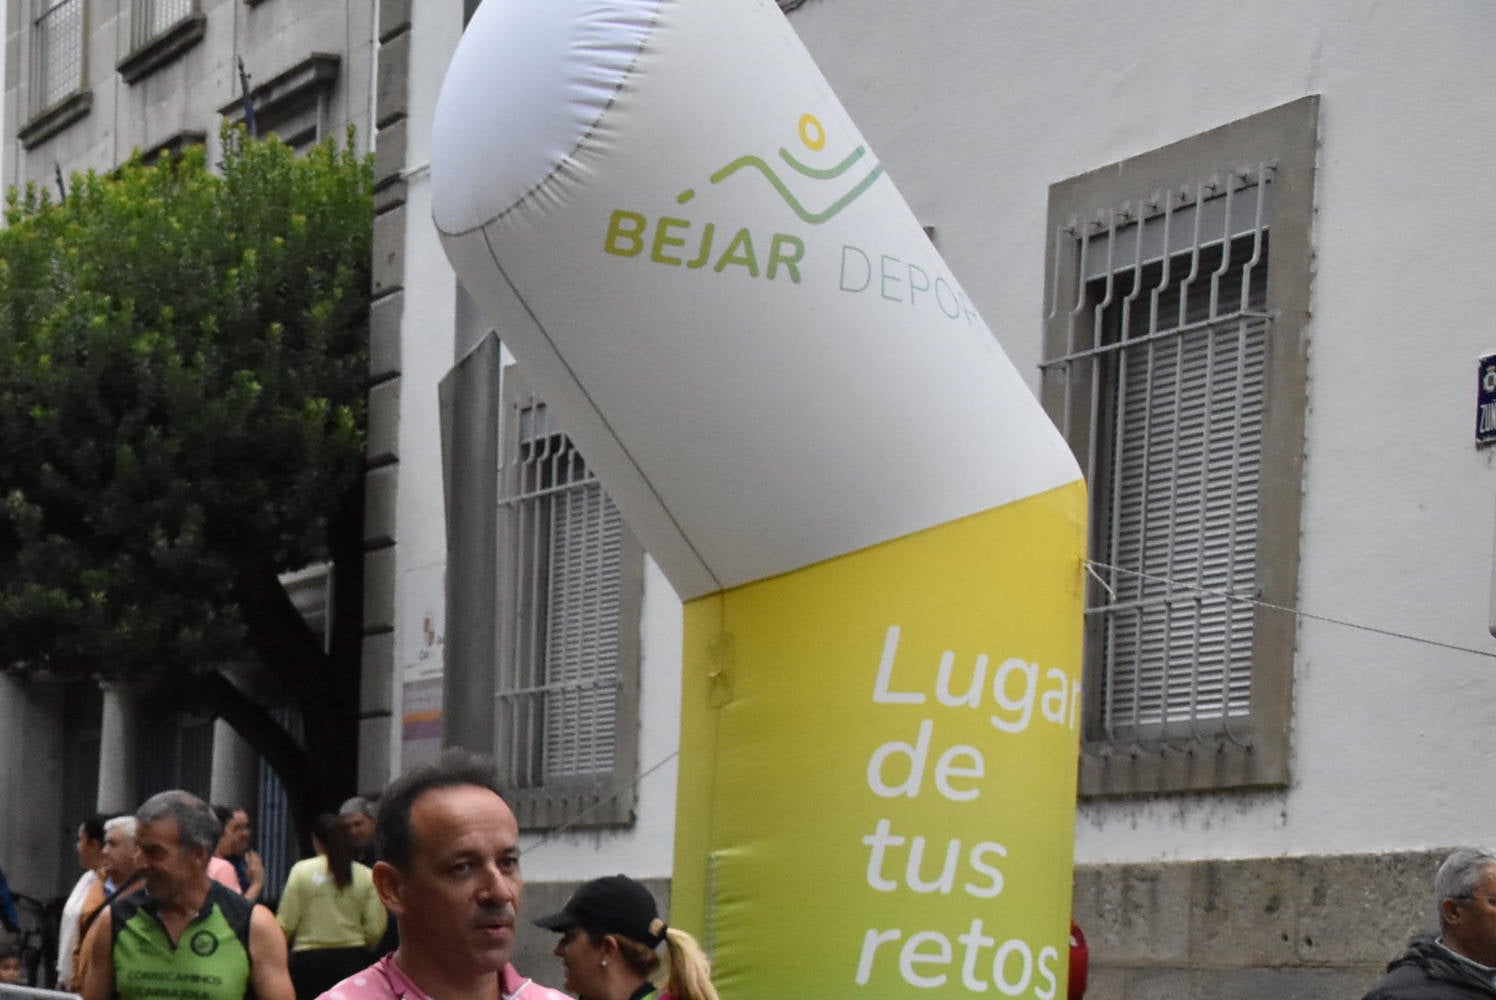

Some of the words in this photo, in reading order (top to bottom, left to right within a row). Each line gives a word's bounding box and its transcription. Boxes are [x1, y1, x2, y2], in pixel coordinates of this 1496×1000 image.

[605, 189, 805, 284] BÉJAR
[872, 625, 1081, 733] Lugar
[866, 719, 985, 801] de
[862, 818, 1008, 899] tus
